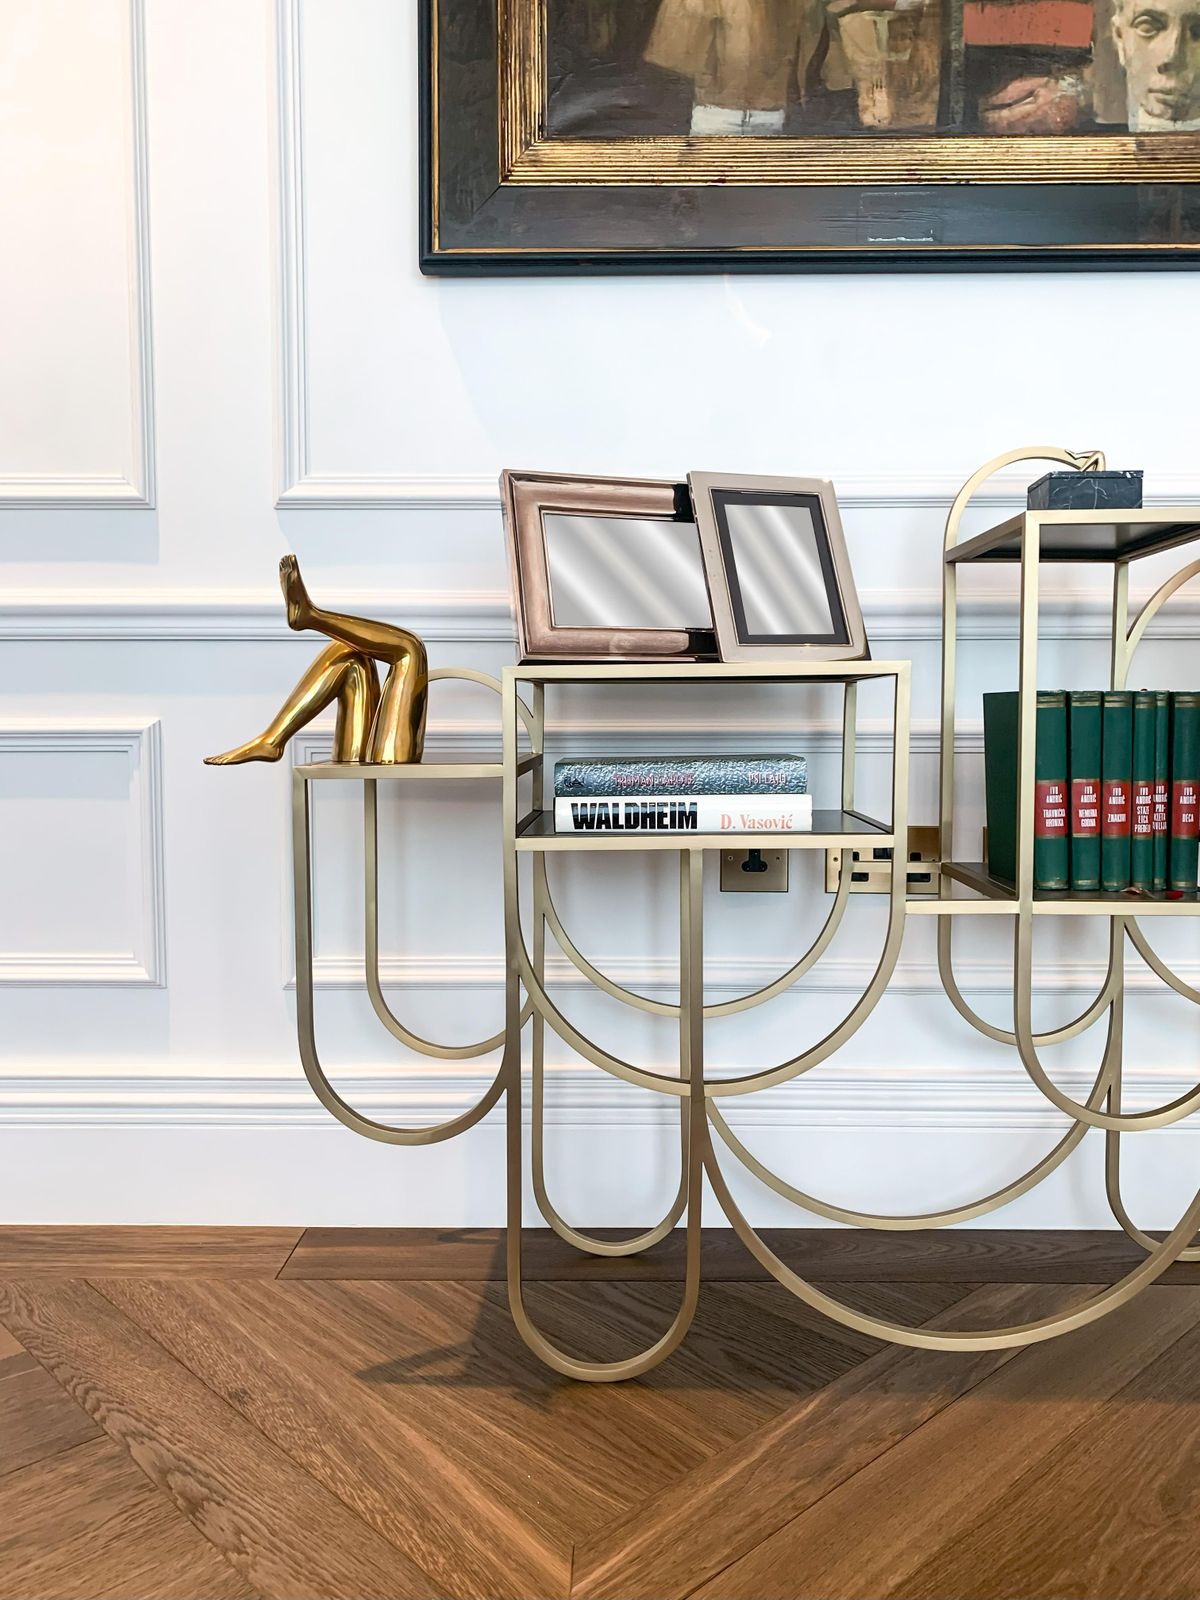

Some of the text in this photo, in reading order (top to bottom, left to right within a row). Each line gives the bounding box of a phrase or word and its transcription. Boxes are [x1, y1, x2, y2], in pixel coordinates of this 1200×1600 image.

[571, 802, 698, 830] WALDHEIM
[720, 814, 793, 830] D. Vasović
